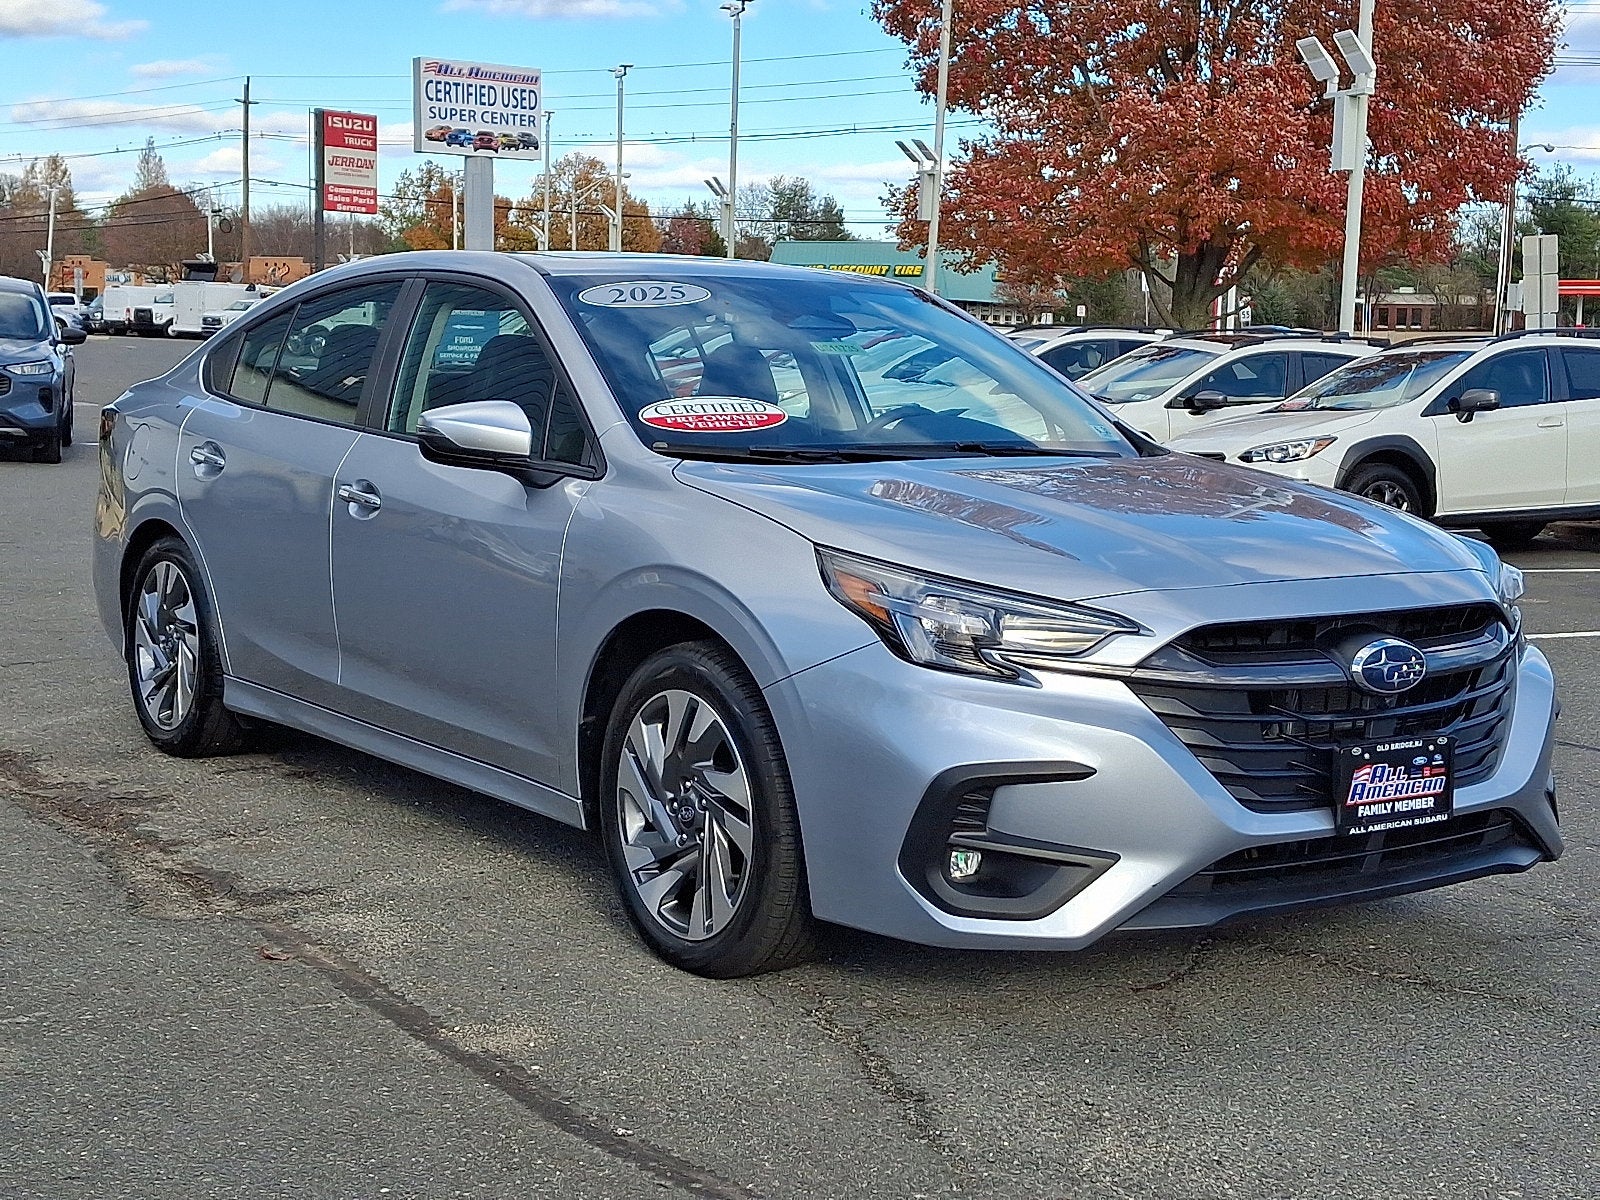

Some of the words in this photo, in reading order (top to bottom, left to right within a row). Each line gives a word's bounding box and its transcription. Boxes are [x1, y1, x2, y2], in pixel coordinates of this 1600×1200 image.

[425, 79, 498, 107] CERTIFIED
[501, 86, 538, 111] USED
[428, 106, 477, 123] SUPER
[480, 110, 537, 128] CENTER
[327, 115, 373, 131] ISUZU
[344, 136, 373, 147] TRUCK
[328, 185, 374, 196] Commercial
[327, 193, 350, 203] Sales
[352, 195, 375, 205] Parts
[336, 203, 366, 213] Service
[894, 265, 923, 276] TIRE
[608, 285, 686, 304] 2025
[454, 336, 474, 344] FORD
[654, 402, 767, 415] CERTIFIED
[665, 413, 769, 424] PRE-OWNED
[682, 420, 759, 429] VEHICLE
[1376, 744, 1390, 752] OLD
[1358, 801, 1393, 817] FAMILY
[1394, 797, 1435, 813] MEMBER
[1349, 827, 1367, 835] ALL
[1368, 818, 1413, 833] AMERICAN
[1413, 813, 1448, 826] SUBARU
